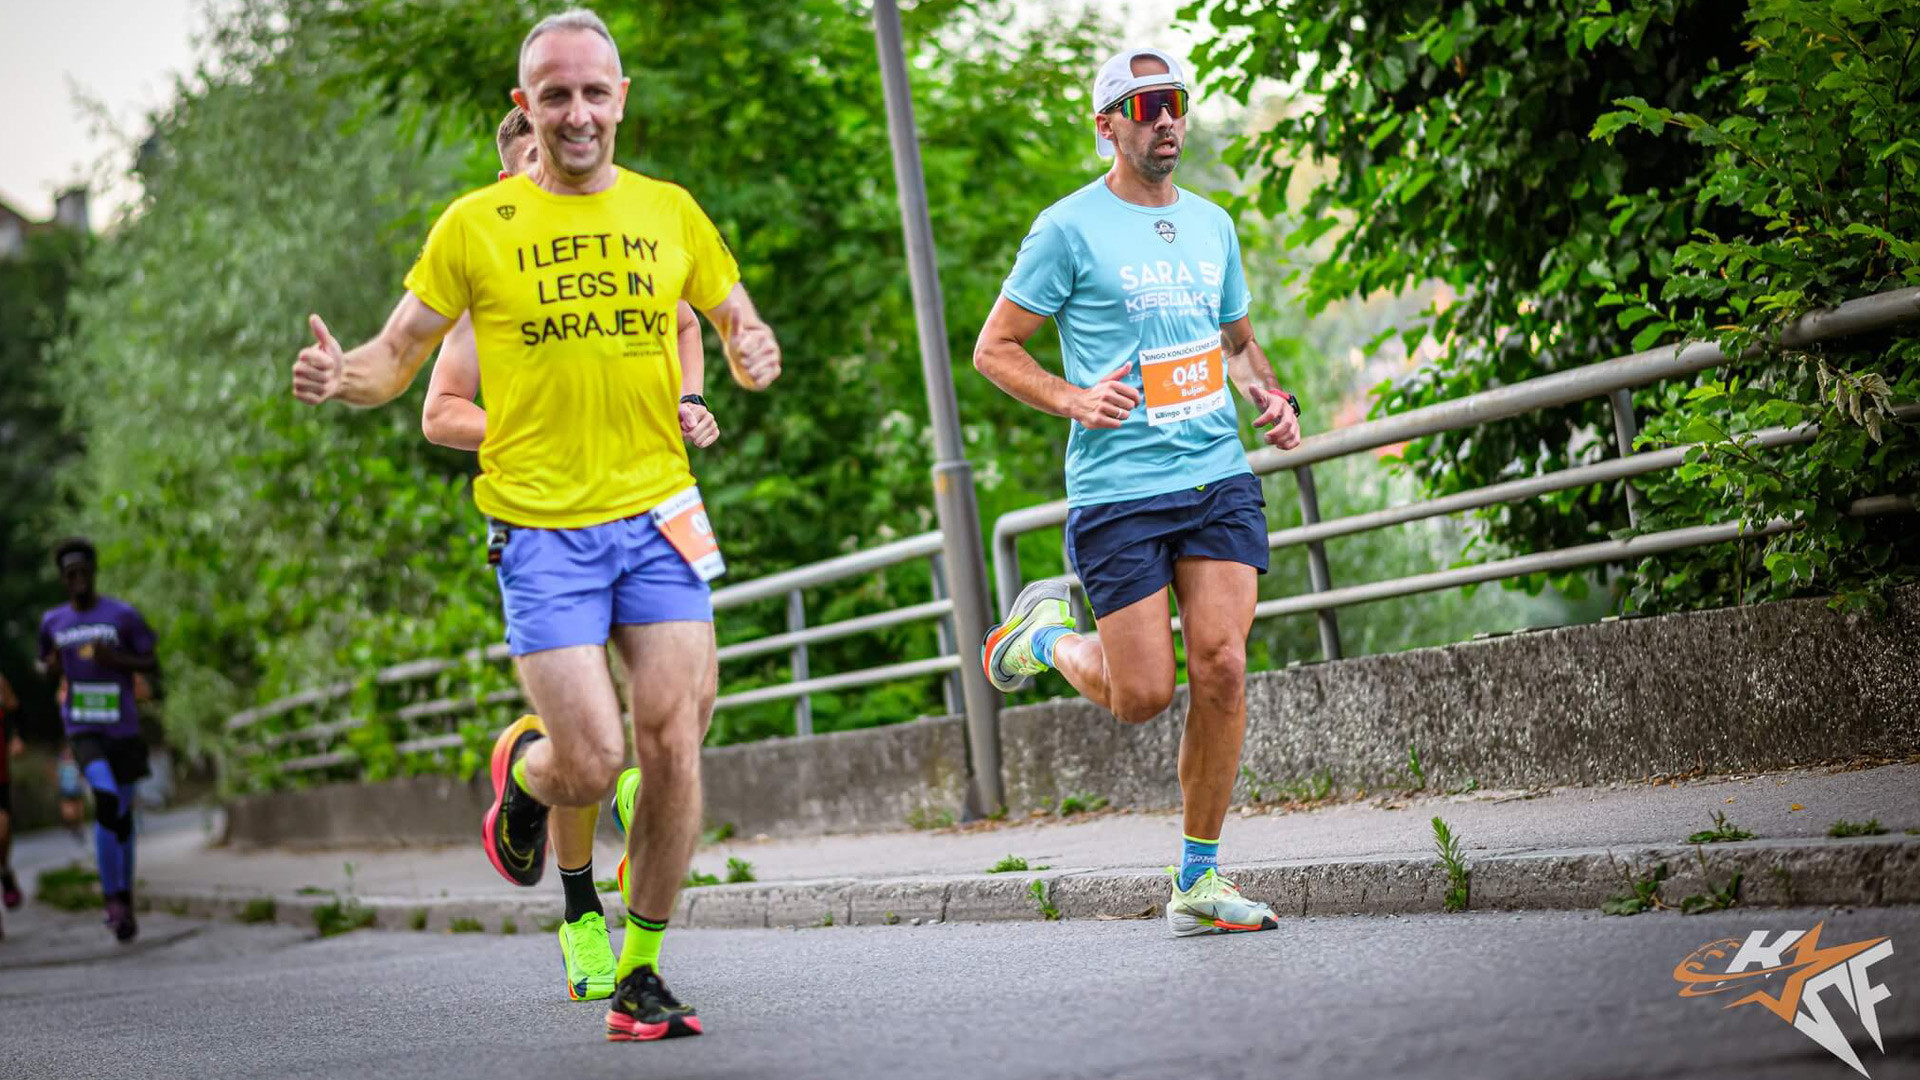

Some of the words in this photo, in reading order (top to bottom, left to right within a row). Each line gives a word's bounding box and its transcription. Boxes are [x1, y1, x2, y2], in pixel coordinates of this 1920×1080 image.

[517, 247, 525, 272] I
[533, 233, 612, 268] LEFT
[622, 233, 659, 263] MY
[538, 271, 618, 306] LEGS
[628, 271, 655, 297] IN
[1120, 261, 1195, 290] SARA
[521, 309, 669, 346] SARAJEVO
[1143, 352, 1167, 362] BINGO
[1173, 360, 1208, 386] 045
